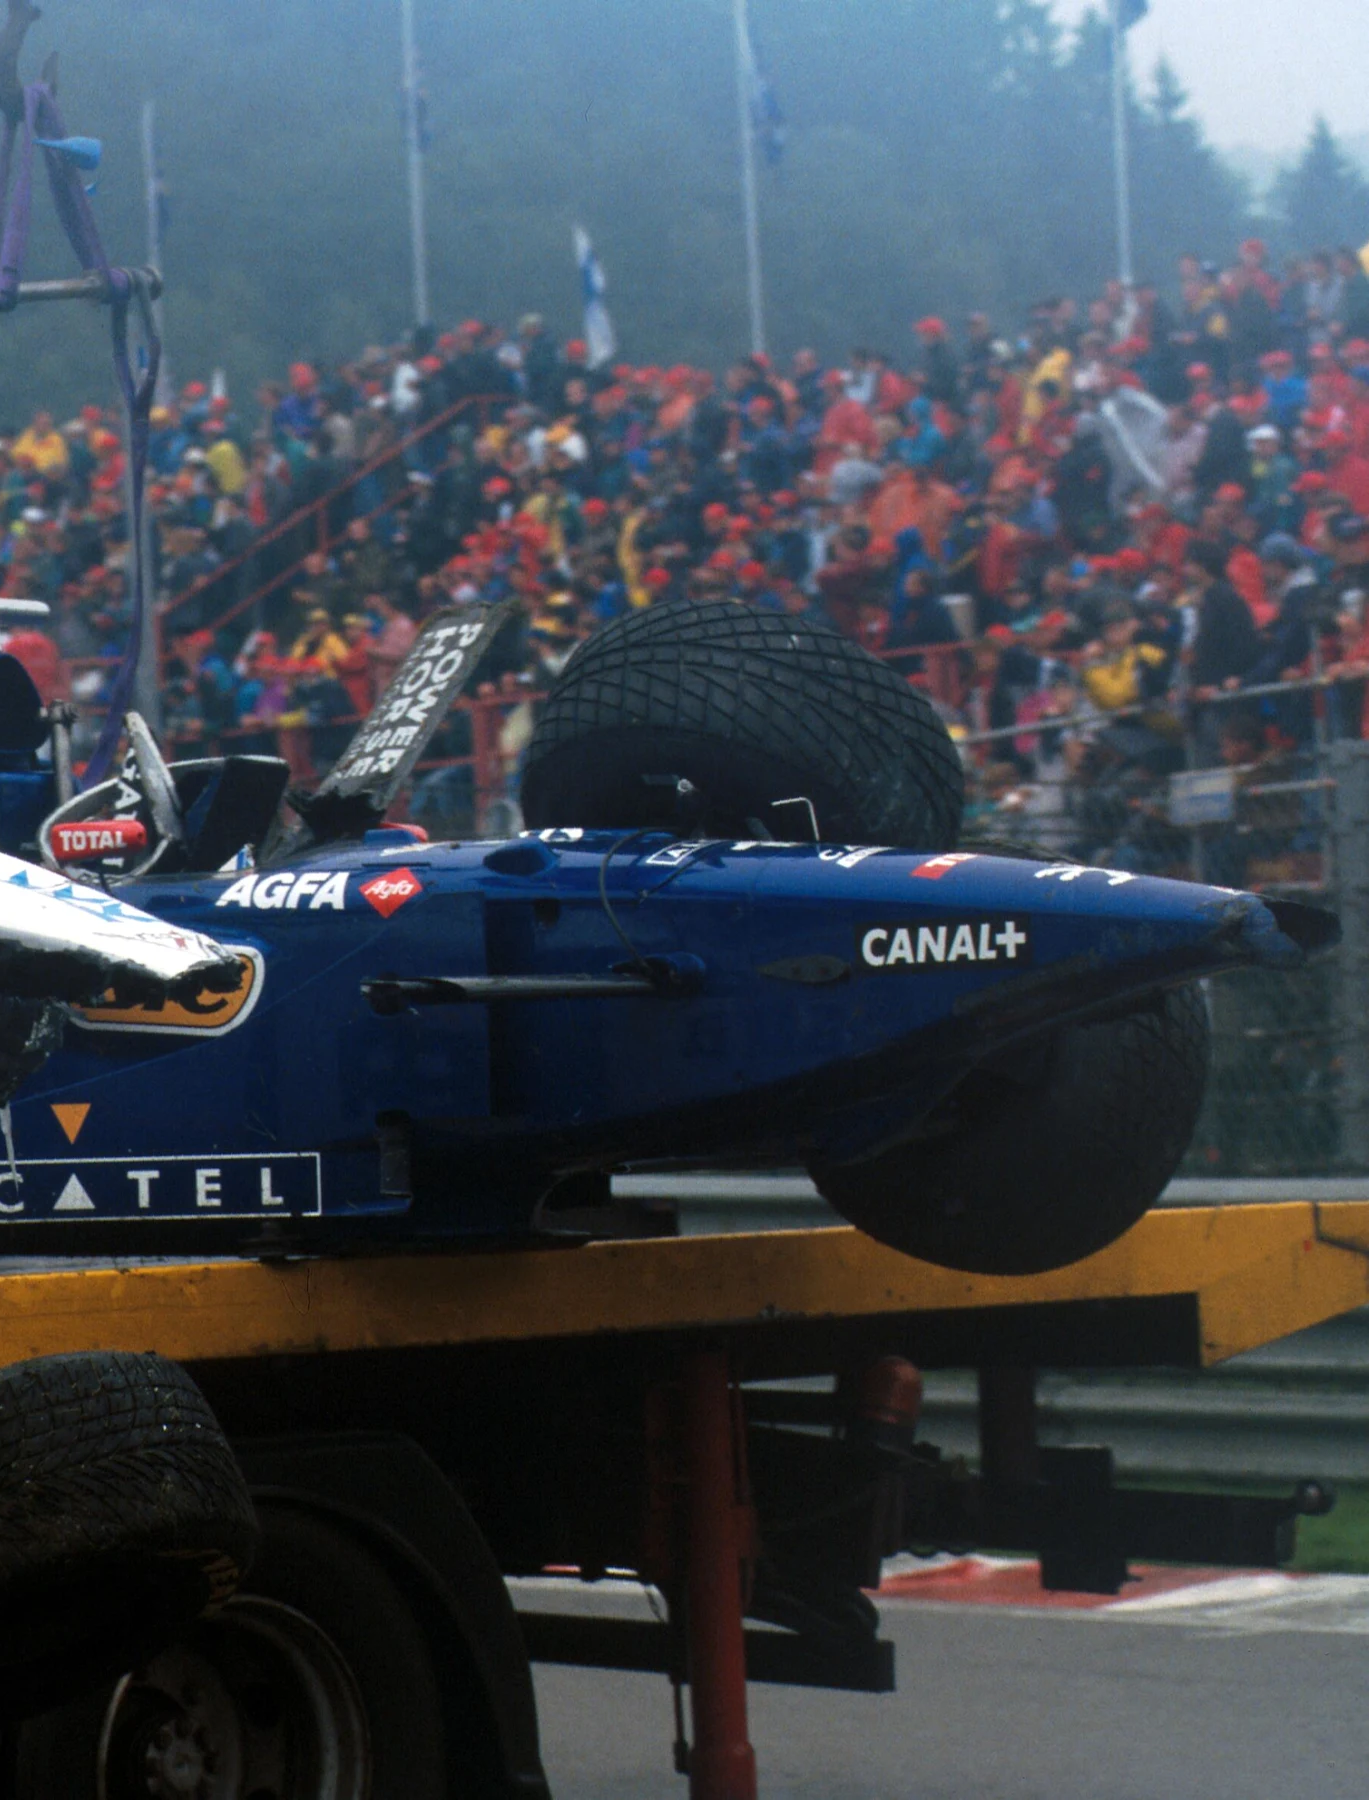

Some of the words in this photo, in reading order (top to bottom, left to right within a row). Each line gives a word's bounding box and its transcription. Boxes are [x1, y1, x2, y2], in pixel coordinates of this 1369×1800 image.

[344, 626, 458, 778] HORSE
[370, 622, 485, 773] POWER
[59, 830, 128, 851] TOTAL
[216, 872, 349, 909] AGFA
[364, 878, 417, 900] Agfa
[862, 921, 1027, 967] CANAL+
